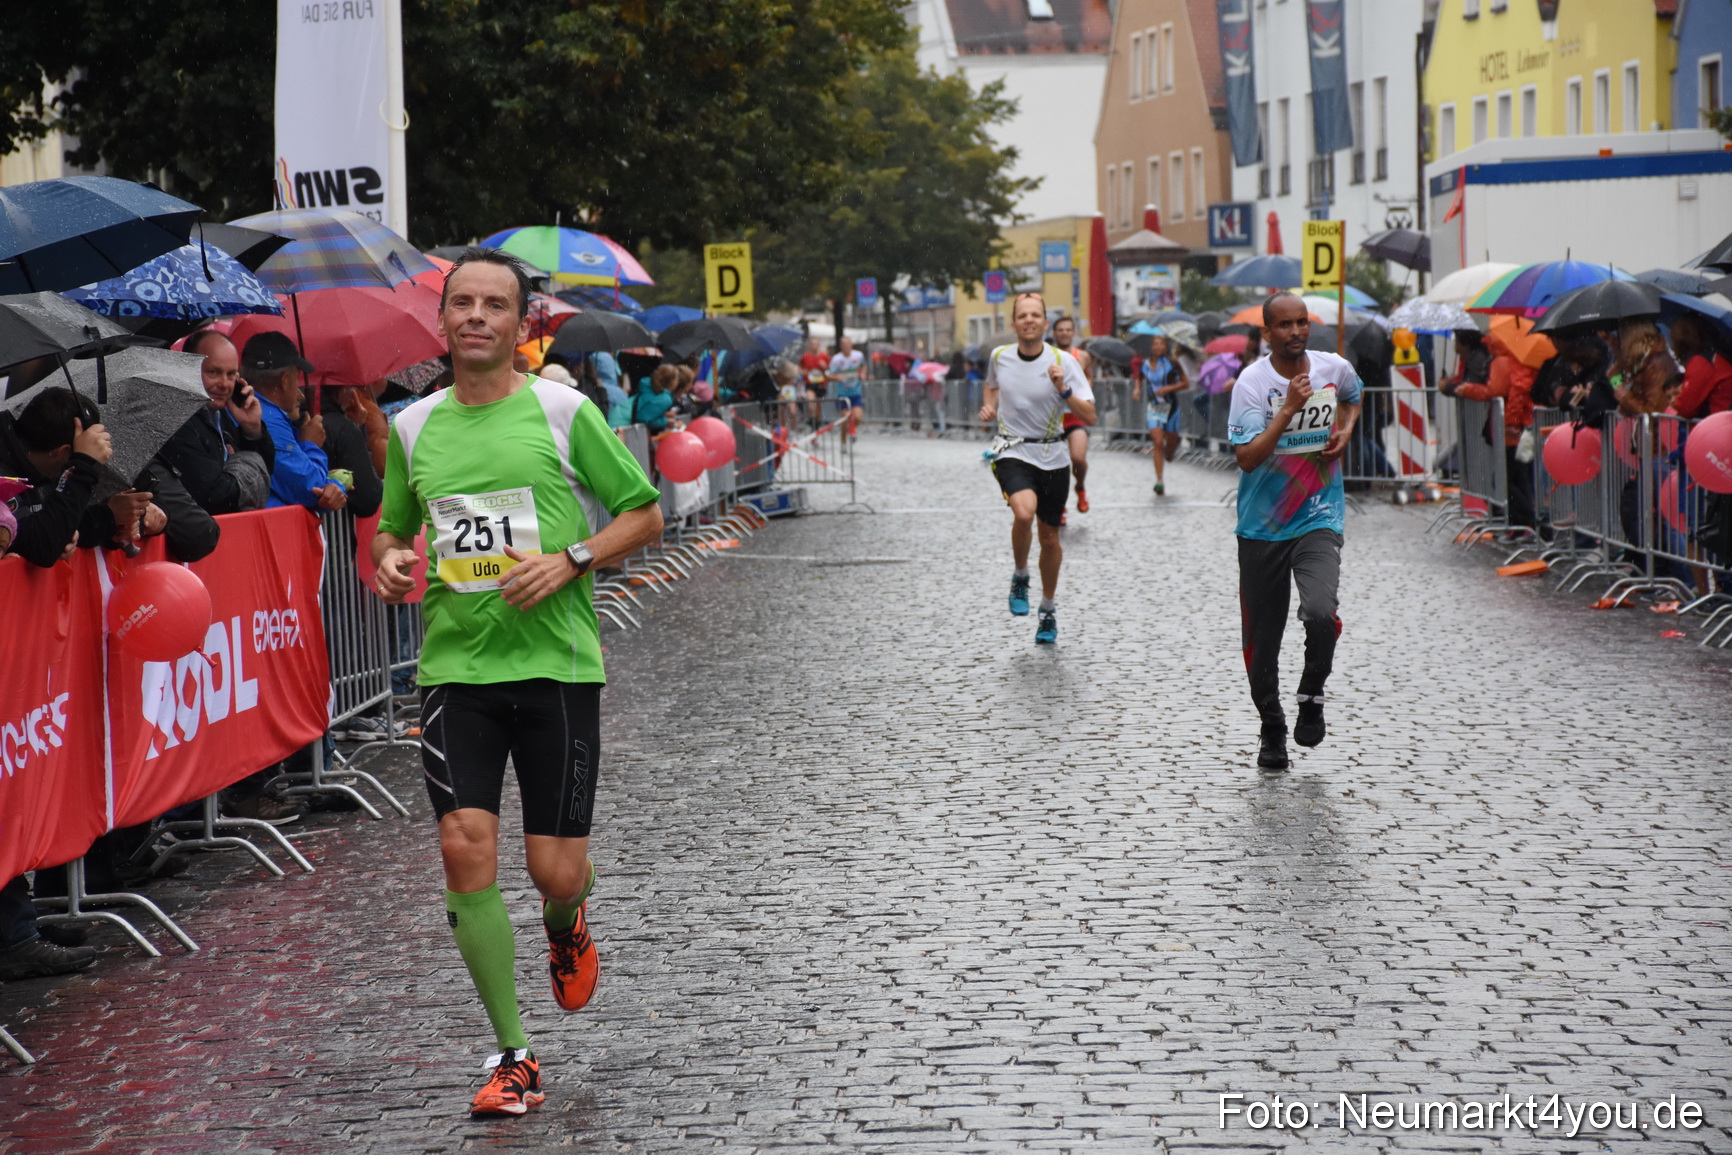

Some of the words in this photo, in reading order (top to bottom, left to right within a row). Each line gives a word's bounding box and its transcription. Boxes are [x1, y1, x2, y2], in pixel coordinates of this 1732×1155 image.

[1480, 50, 1509, 84] HOTEL
[1308, 223, 1341, 236] Block
[710, 247, 744, 259] Block
[1314, 242, 1334, 275] D
[718, 265, 741, 297] D
[1284, 404, 1332, 433] 722
[473, 493, 524, 509] BOCK
[453, 515, 513, 553] 251
[473, 562, 501, 578] Udo
[569, 739, 590, 824] 2XU
